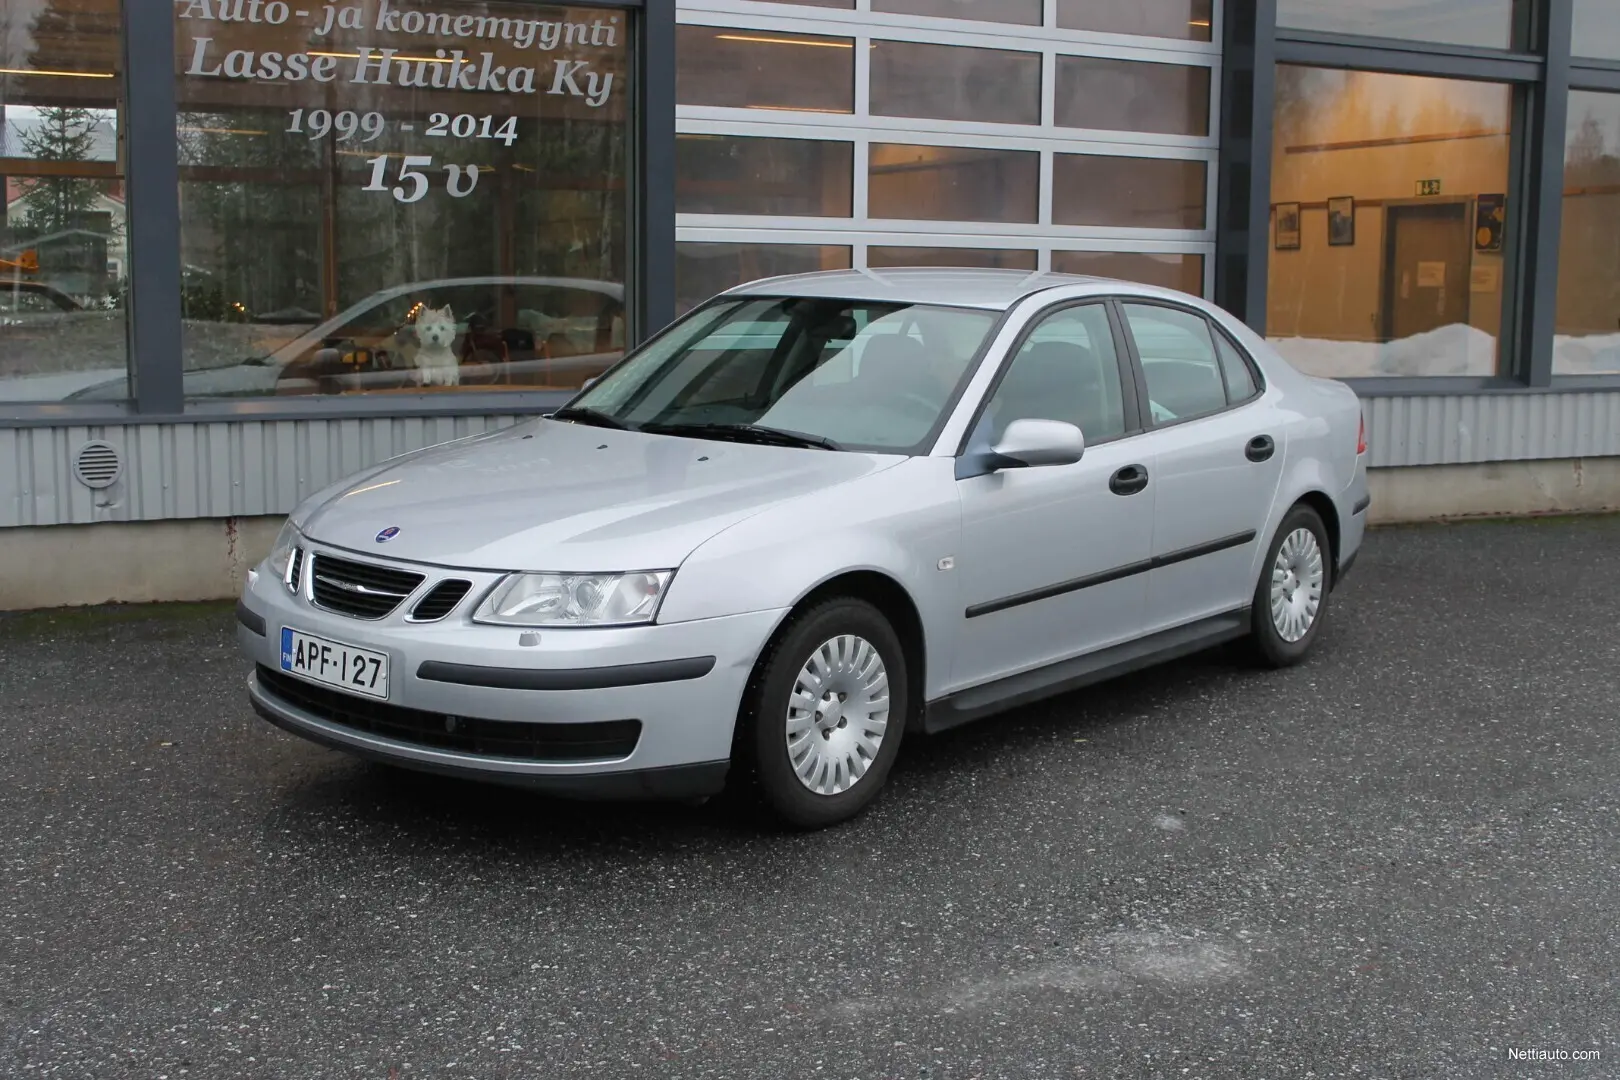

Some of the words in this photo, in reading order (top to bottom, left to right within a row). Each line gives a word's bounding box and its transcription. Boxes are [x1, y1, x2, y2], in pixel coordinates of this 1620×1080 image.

[314, 0, 364, 36] ja
[375, 0, 618, 51] konemyynti
[184, 36, 337, 83] Lasse
[349, 46, 537, 94] Huikka
[547, 59, 614, 107] Ky
[285, 108, 385, 143] 1999
[425, 112, 518, 147] 2014
[361, 154, 432, 203] 15
[442, 163, 479, 198] v
[295, 638, 382, 688] APF-127
